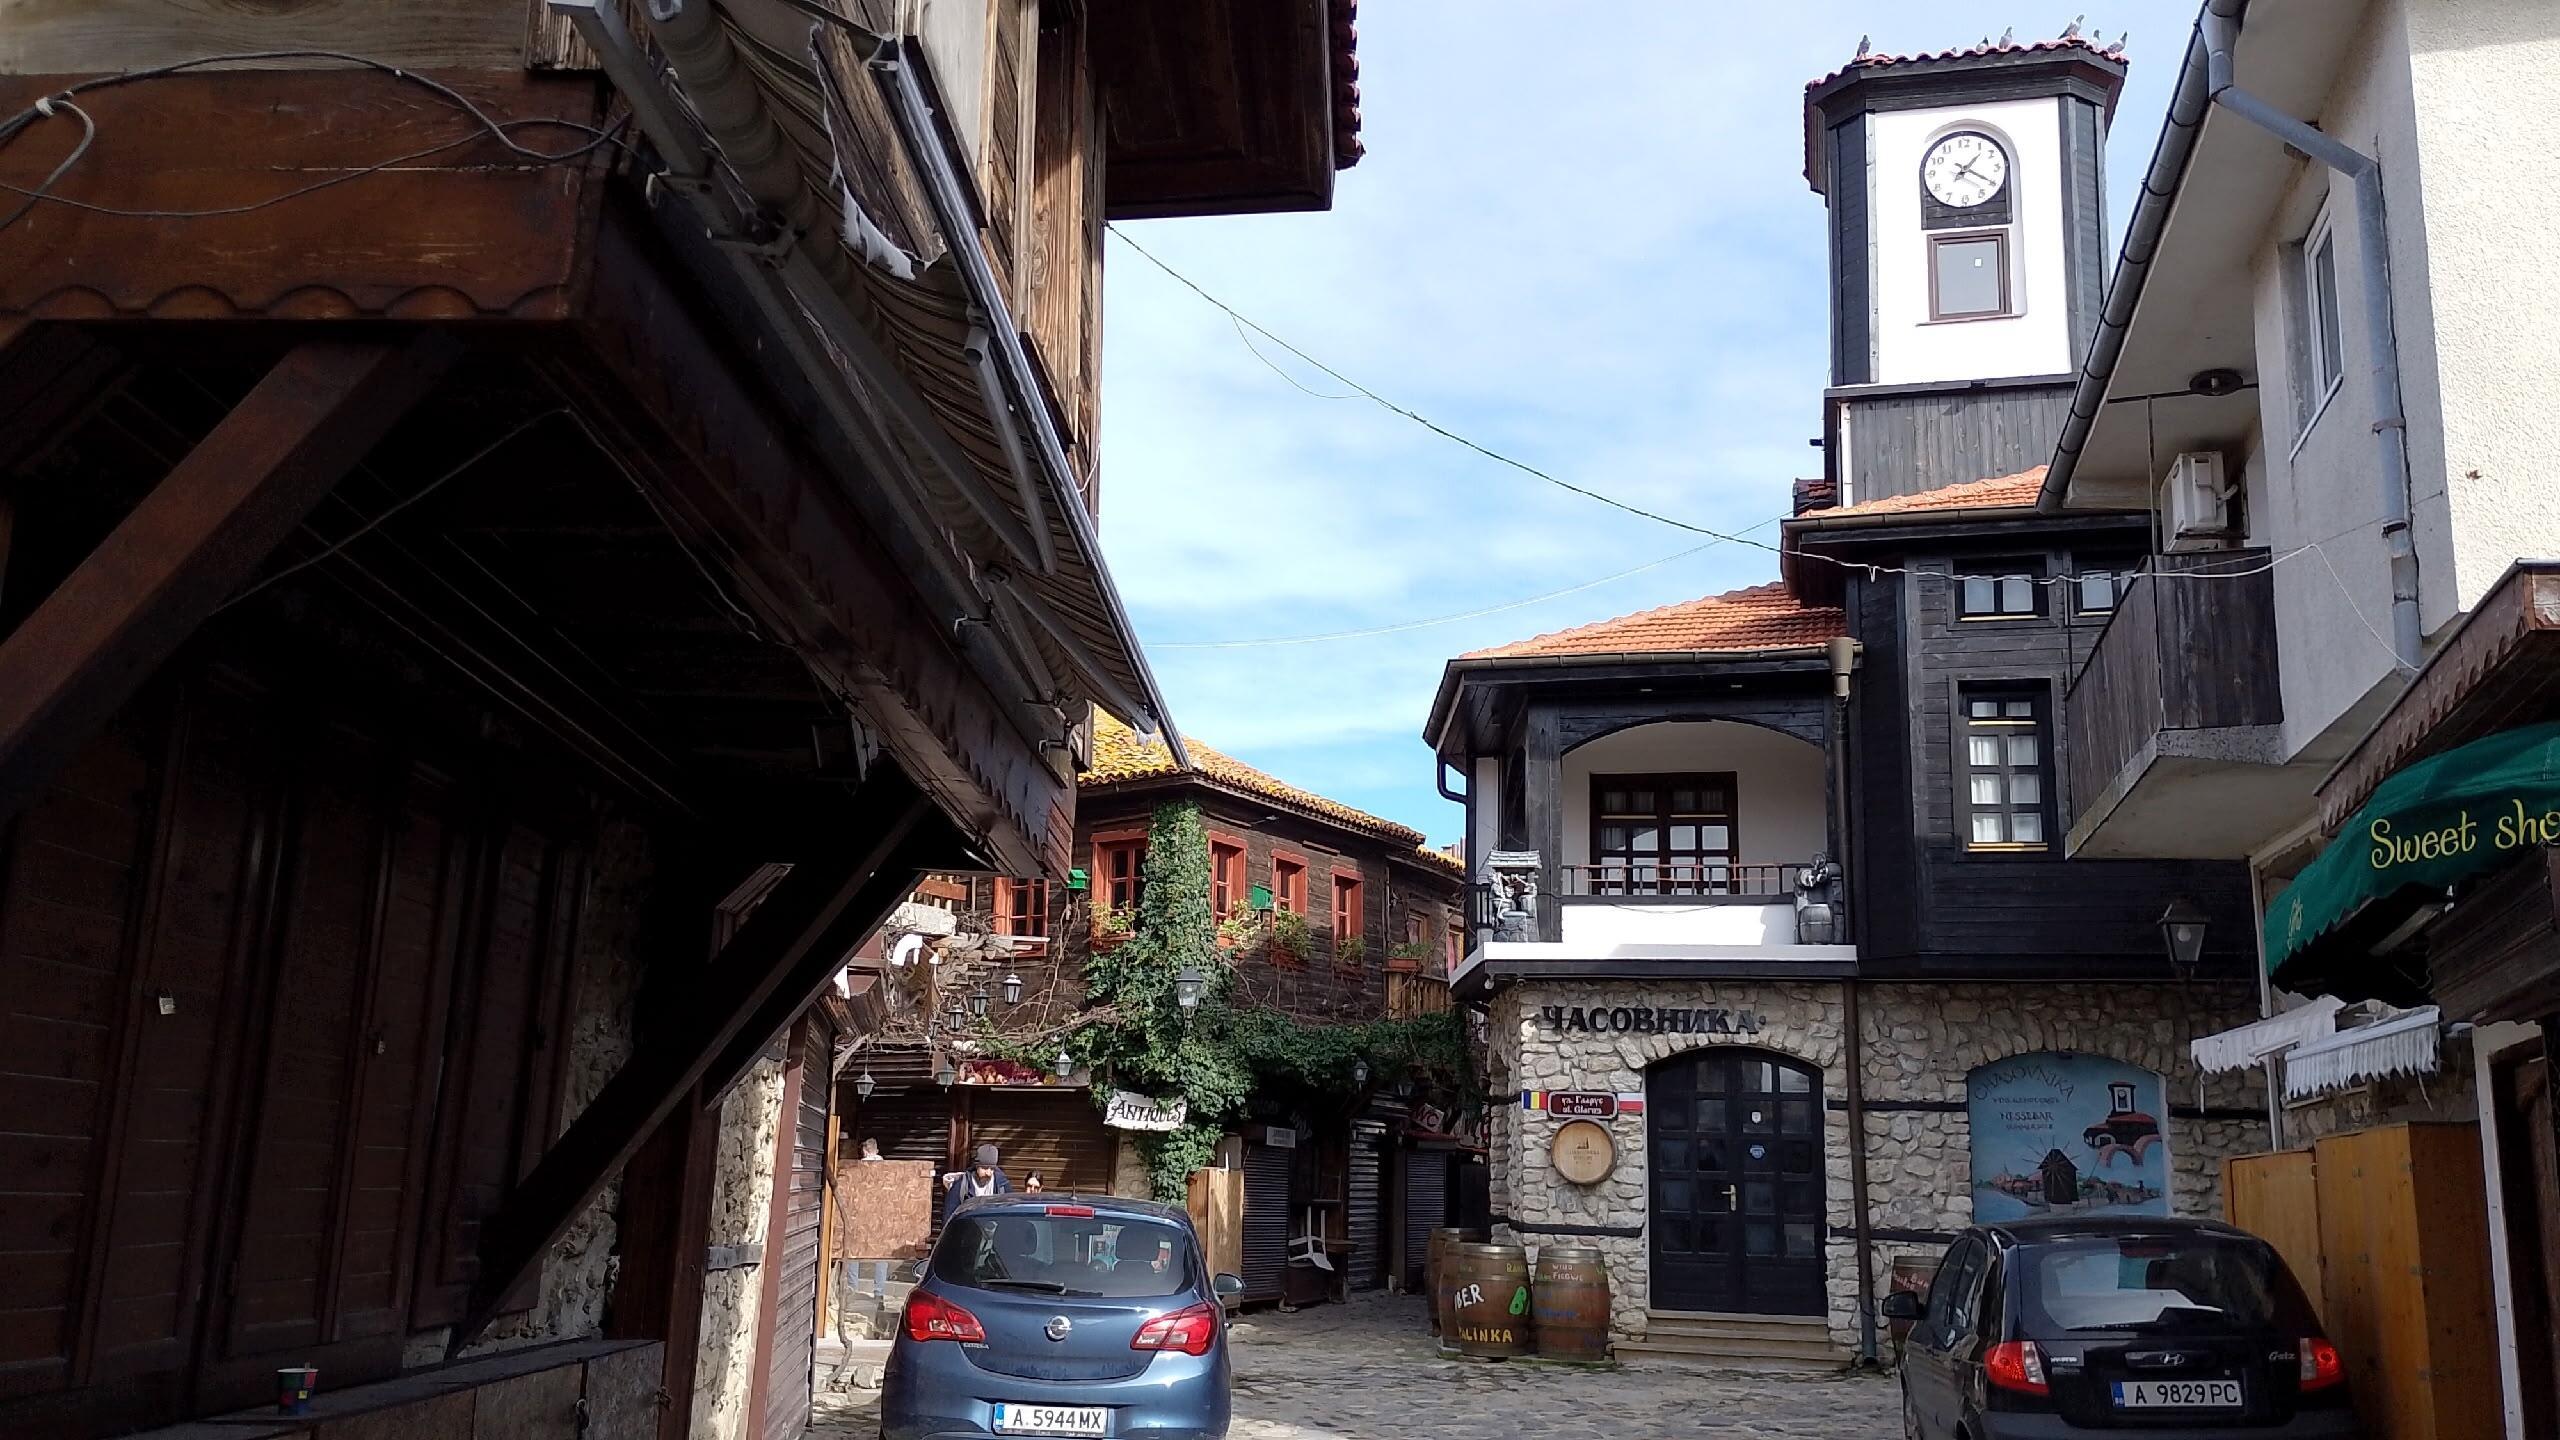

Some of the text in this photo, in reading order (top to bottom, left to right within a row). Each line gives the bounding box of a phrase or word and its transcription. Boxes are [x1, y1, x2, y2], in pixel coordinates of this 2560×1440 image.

[1958, 138, 1970, 148] 12
[1942, 144, 1951, 154] 11
[1931, 157, 1944, 165] 10
[1993, 163, 2001, 173] 3
[1927, 170, 1936, 179] 9
[1945, 192, 1953, 202] 7
[1978, 189, 1985, 199] 5
[2371, 810, 2477, 869] Sweet
[1542, 1005, 1759, 1035] ЧАСОВНИКА
